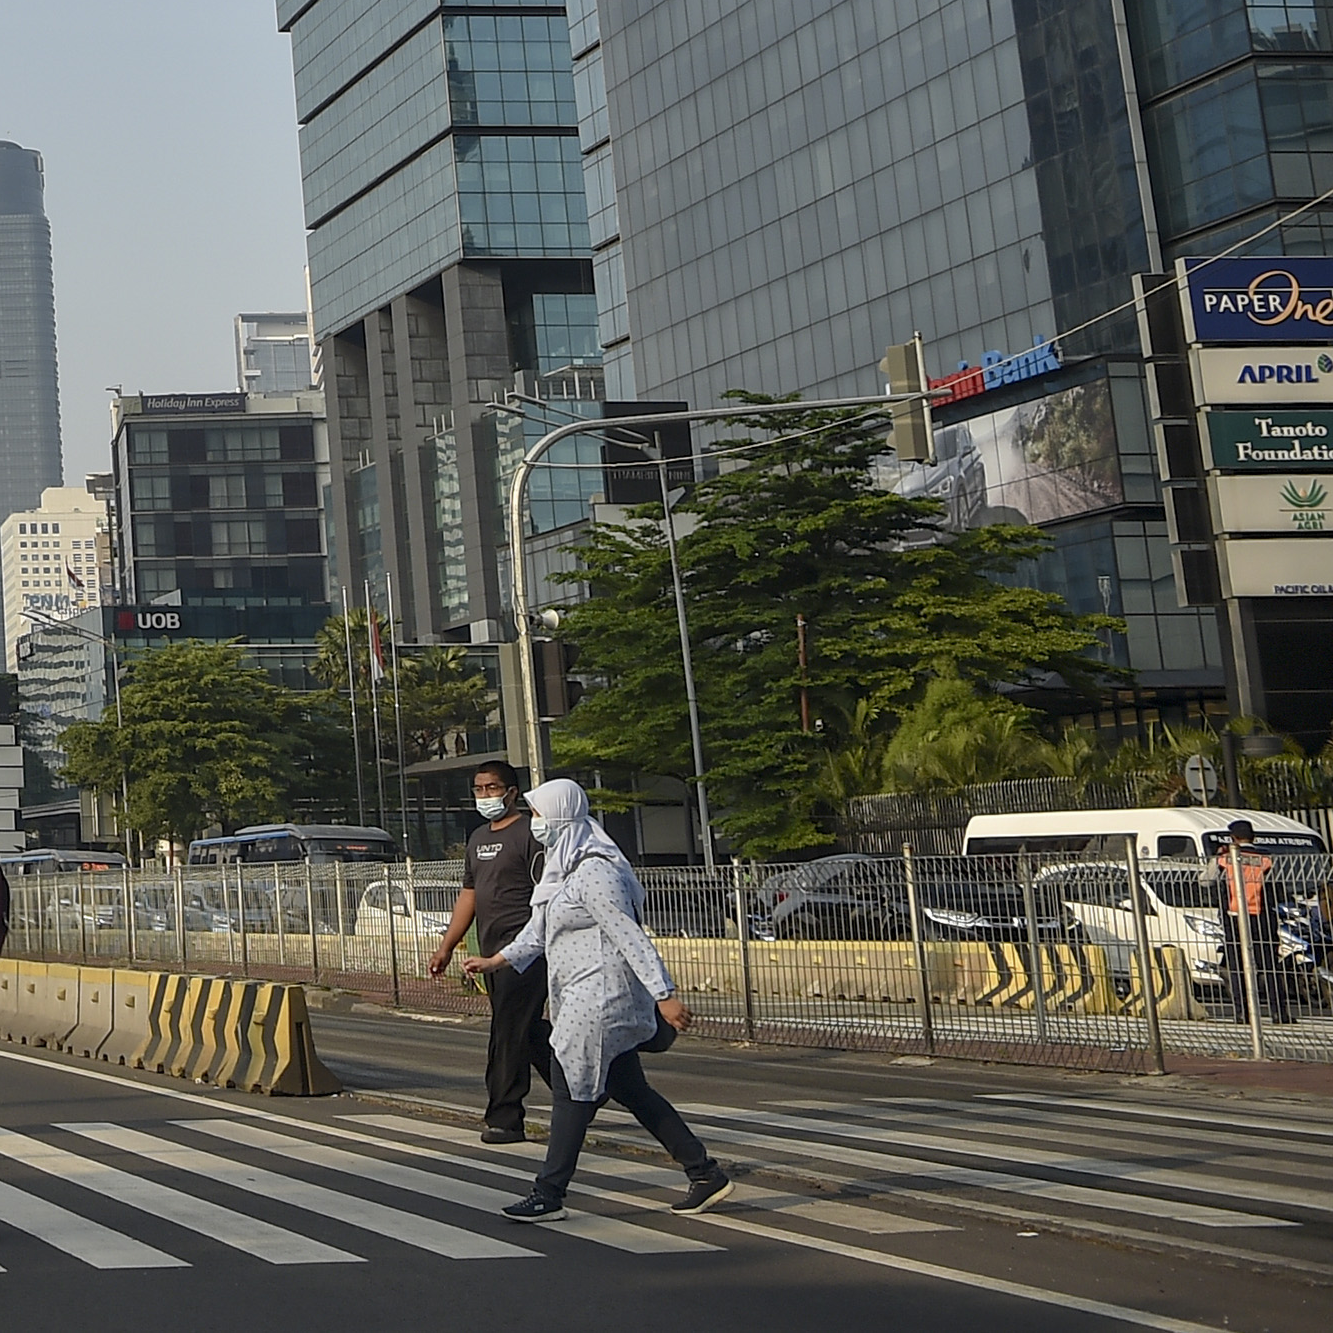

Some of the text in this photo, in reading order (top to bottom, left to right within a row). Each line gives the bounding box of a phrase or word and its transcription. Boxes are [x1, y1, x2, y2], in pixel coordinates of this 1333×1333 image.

[1203, 293, 1285, 313] PAPER
[1237, 364, 1319, 384] APRIL
[147, 397, 239, 410] Holiday Inn Express
[1254, 417, 1328, 437] Tanoto
[1292, 512, 1326, 522] ASIAN
[1297, 521, 1323, 530] AGRI
[1274, 584, 1310, 594] PACIFIC
[1311, 584, 1328, 594] OIL
[29, 594, 70, 608] PNM
[137, 612, 181, 629] UOB
